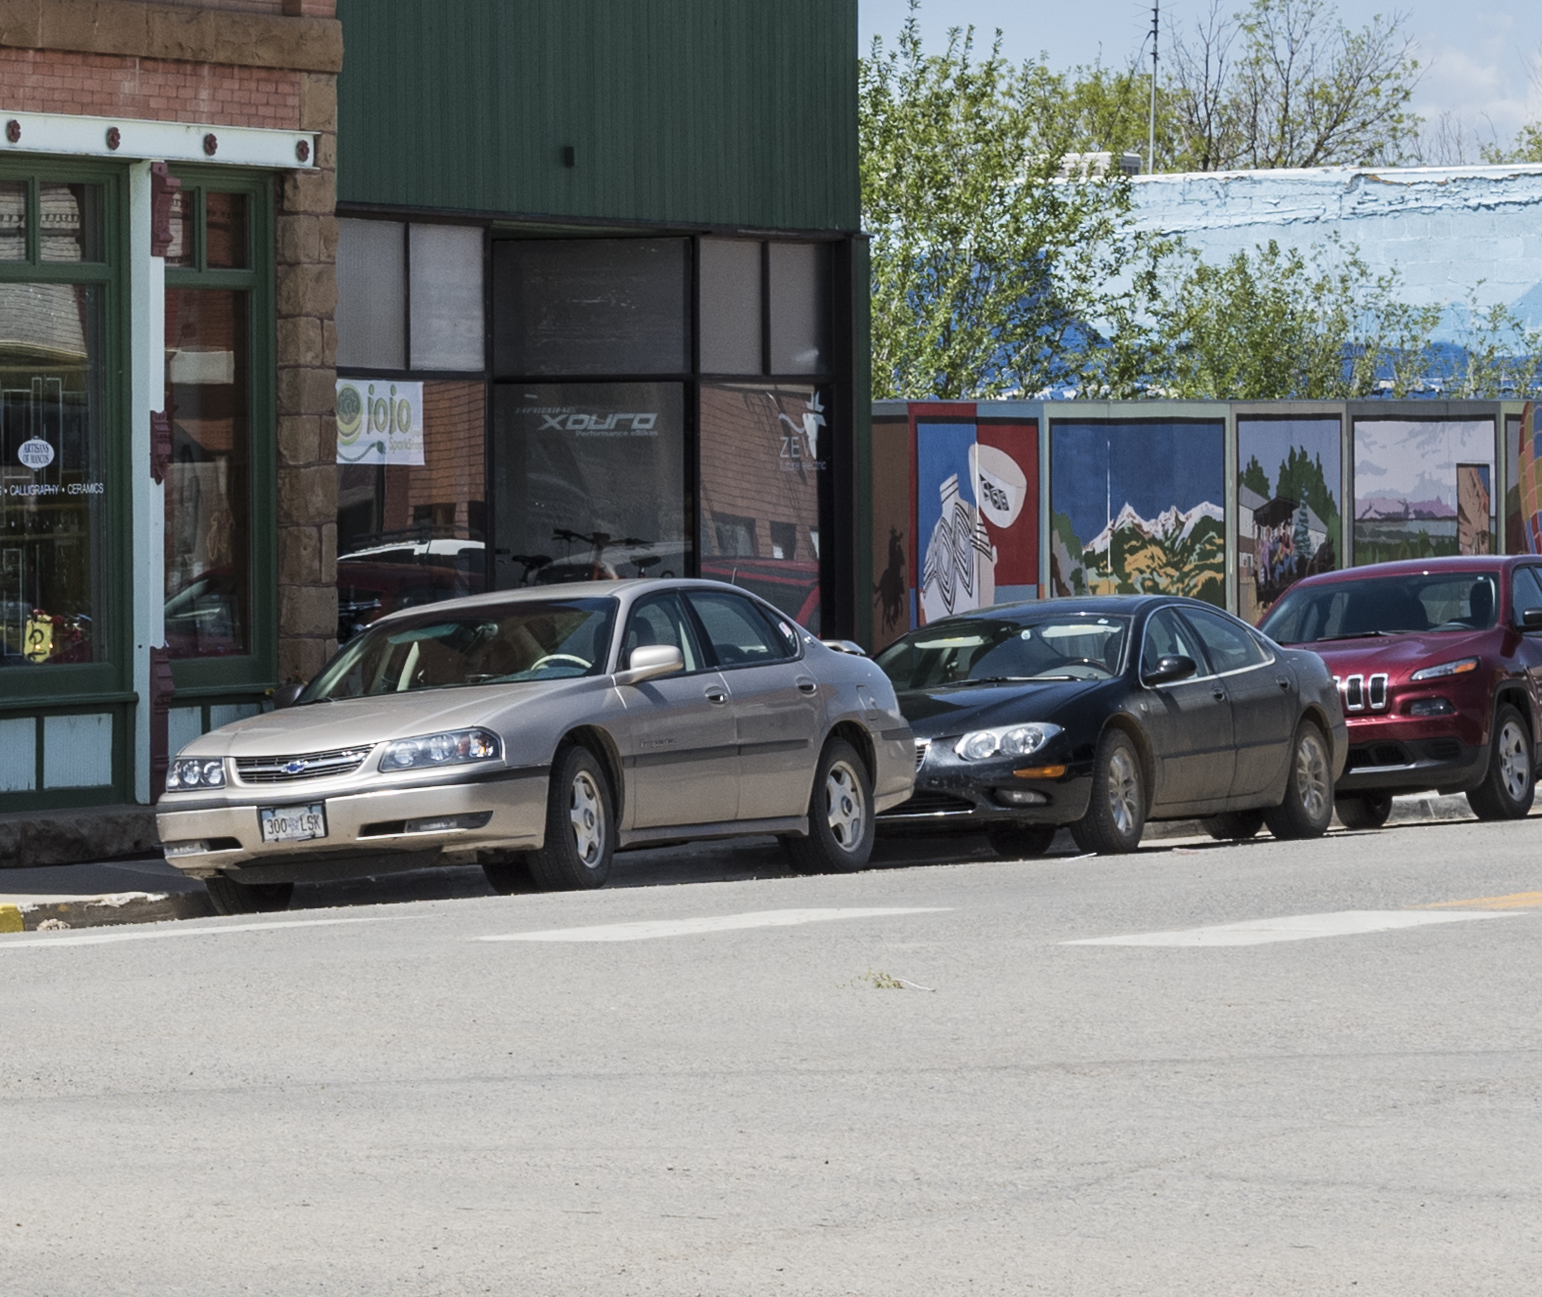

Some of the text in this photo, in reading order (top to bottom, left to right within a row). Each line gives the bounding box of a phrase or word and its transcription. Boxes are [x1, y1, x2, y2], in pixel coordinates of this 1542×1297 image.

[23, 443, 50, 453] ARTISANS
[10, 484, 60, 496] CALLIGRAPHY
[67, 483, 104, 495] CERAMICS
[266, 814, 322, 835] 300 LSK
